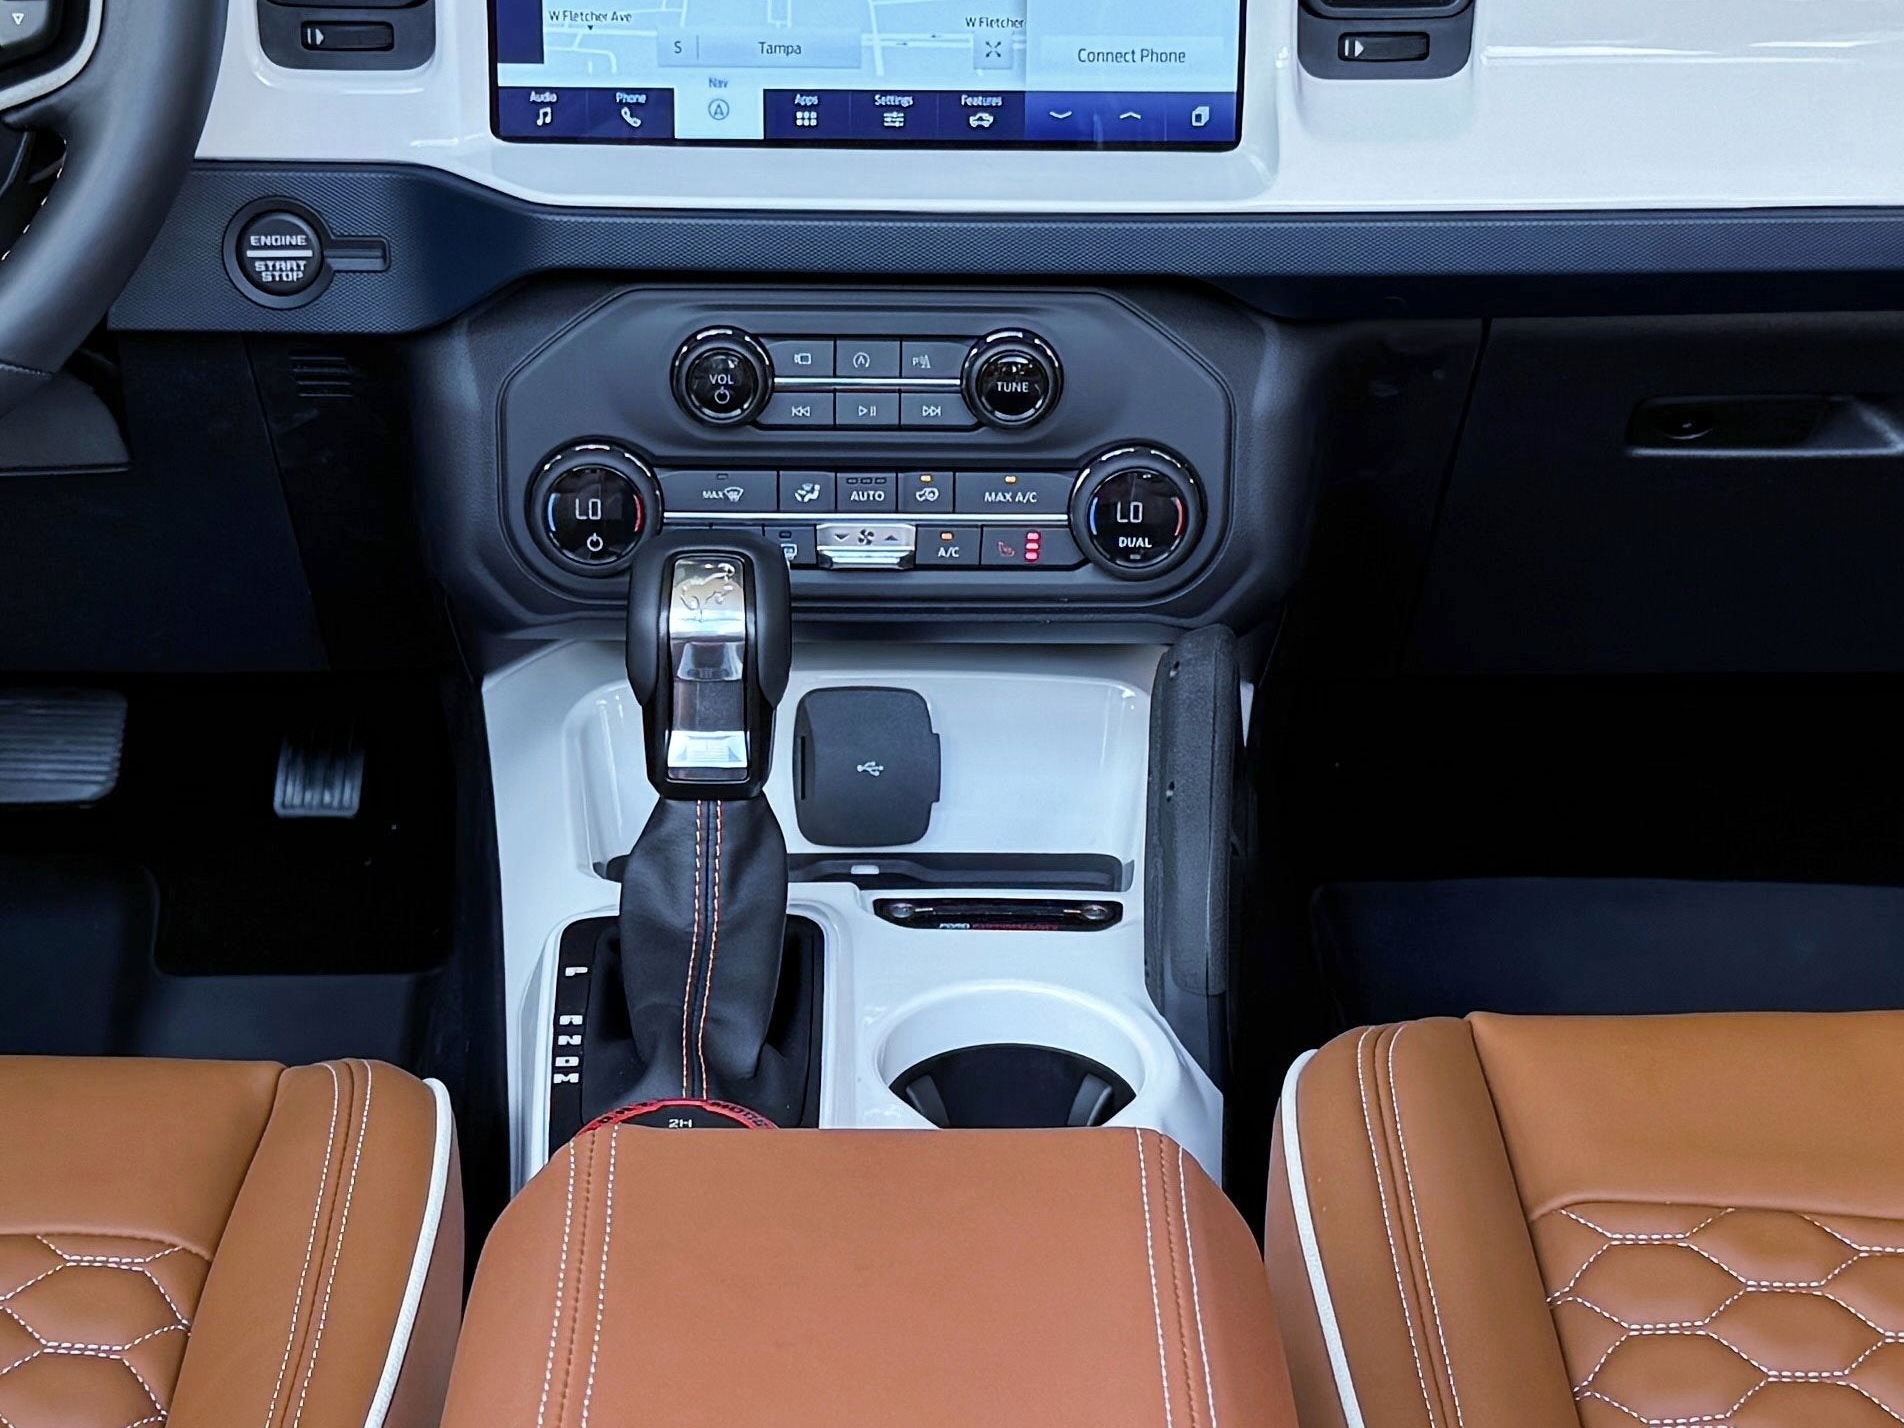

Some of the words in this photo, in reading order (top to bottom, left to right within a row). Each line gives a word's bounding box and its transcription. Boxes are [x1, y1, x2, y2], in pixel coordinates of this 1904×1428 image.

[548, 11, 561, 22] W
[563, 10, 608, 23] Fletcher
[611, 12, 632, 23] Ave
[965, 17, 977, 28] W
[979, 17, 1025, 29] Fletcher
[674, 41, 683, 54] S
[758, 42, 802, 56] Tampa
[1077, 47, 1136, 63] Connect
[1140, 47, 1186, 63] Phone
[708, 77, 728, 89] Nav
[529, 91, 557, 103] Audio
[615, 92, 647, 104] Phone
[794, 93, 818, 106] Apps
[874, 94, 913, 108] Settings
[961, 94, 1003, 107] Features
[250, 234, 308, 247] ENGINE
[254, 259, 307, 272] START
[261, 270, 304, 283] STOP
[709, 373, 734, 385] VOL
[997, 381, 1029, 393] TUNE
[702, 490, 725, 500] MAX
[850, 490, 885, 502] AUTO
[984, 491, 1013, 503] MAX
[1015, 491, 1038, 503] A/C
[575, 498, 602, 520] LO
[1116, 501, 1143, 523] LO
[1118, 536, 1152, 549] DUAL
[938, 546, 960, 559] A/C
[558, 1035, 582, 1046] N
[555, 1056, 579, 1067] D
[553, 1073, 579, 1084] M
[668, 1118, 693, 1129] 2H
